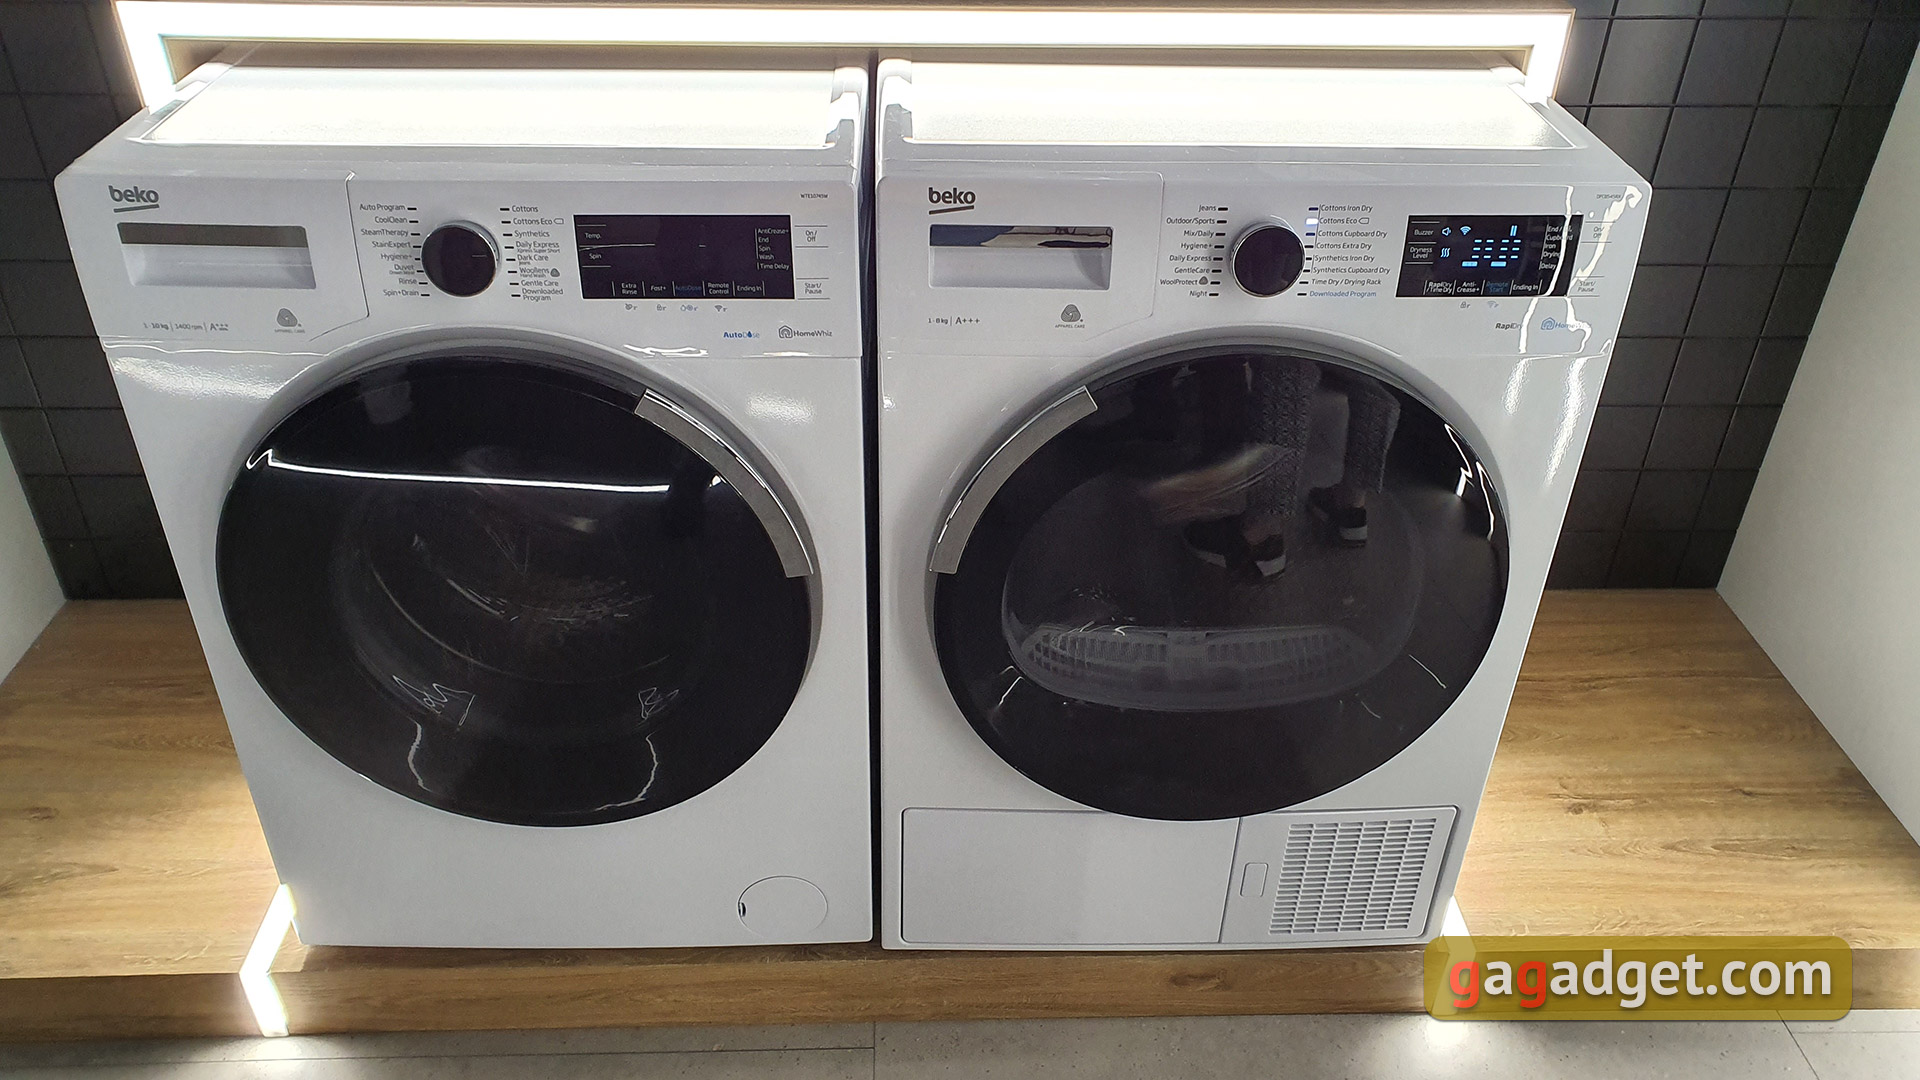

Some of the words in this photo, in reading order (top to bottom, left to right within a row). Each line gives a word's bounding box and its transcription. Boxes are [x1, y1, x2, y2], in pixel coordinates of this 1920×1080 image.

[108, 185, 159, 203] beko
[928, 187, 976, 205] beko
[376, 204, 405, 212] Program
[1198, 204, 1216, 212] Jeans
[1361, 205, 1373, 213] Dry
[513, 217, 540, 225] Cottons
[1166, 217, 1215, 225] Outdoor/Sports
[514, 230, 550, 238] Synthetics
[1183, 230, 1214, 238] Mix/Daily
[1376, 230, 1387, 238] Dry
[515, 241, 532, 249] Daily
[533, 241, 560, 249] Express
[1360, 243, 1372, 251] Dry
[1314, 254, 1348, 262] Synthetics
[1313, 266, 1347, 274] Synthetics
[1347, 266, 1378, 274] Cupboard
[398, 277, 417, 285] Rinse
[1190, 290, 1208, 298] Night
[955, 316, 980, 325] A+++
